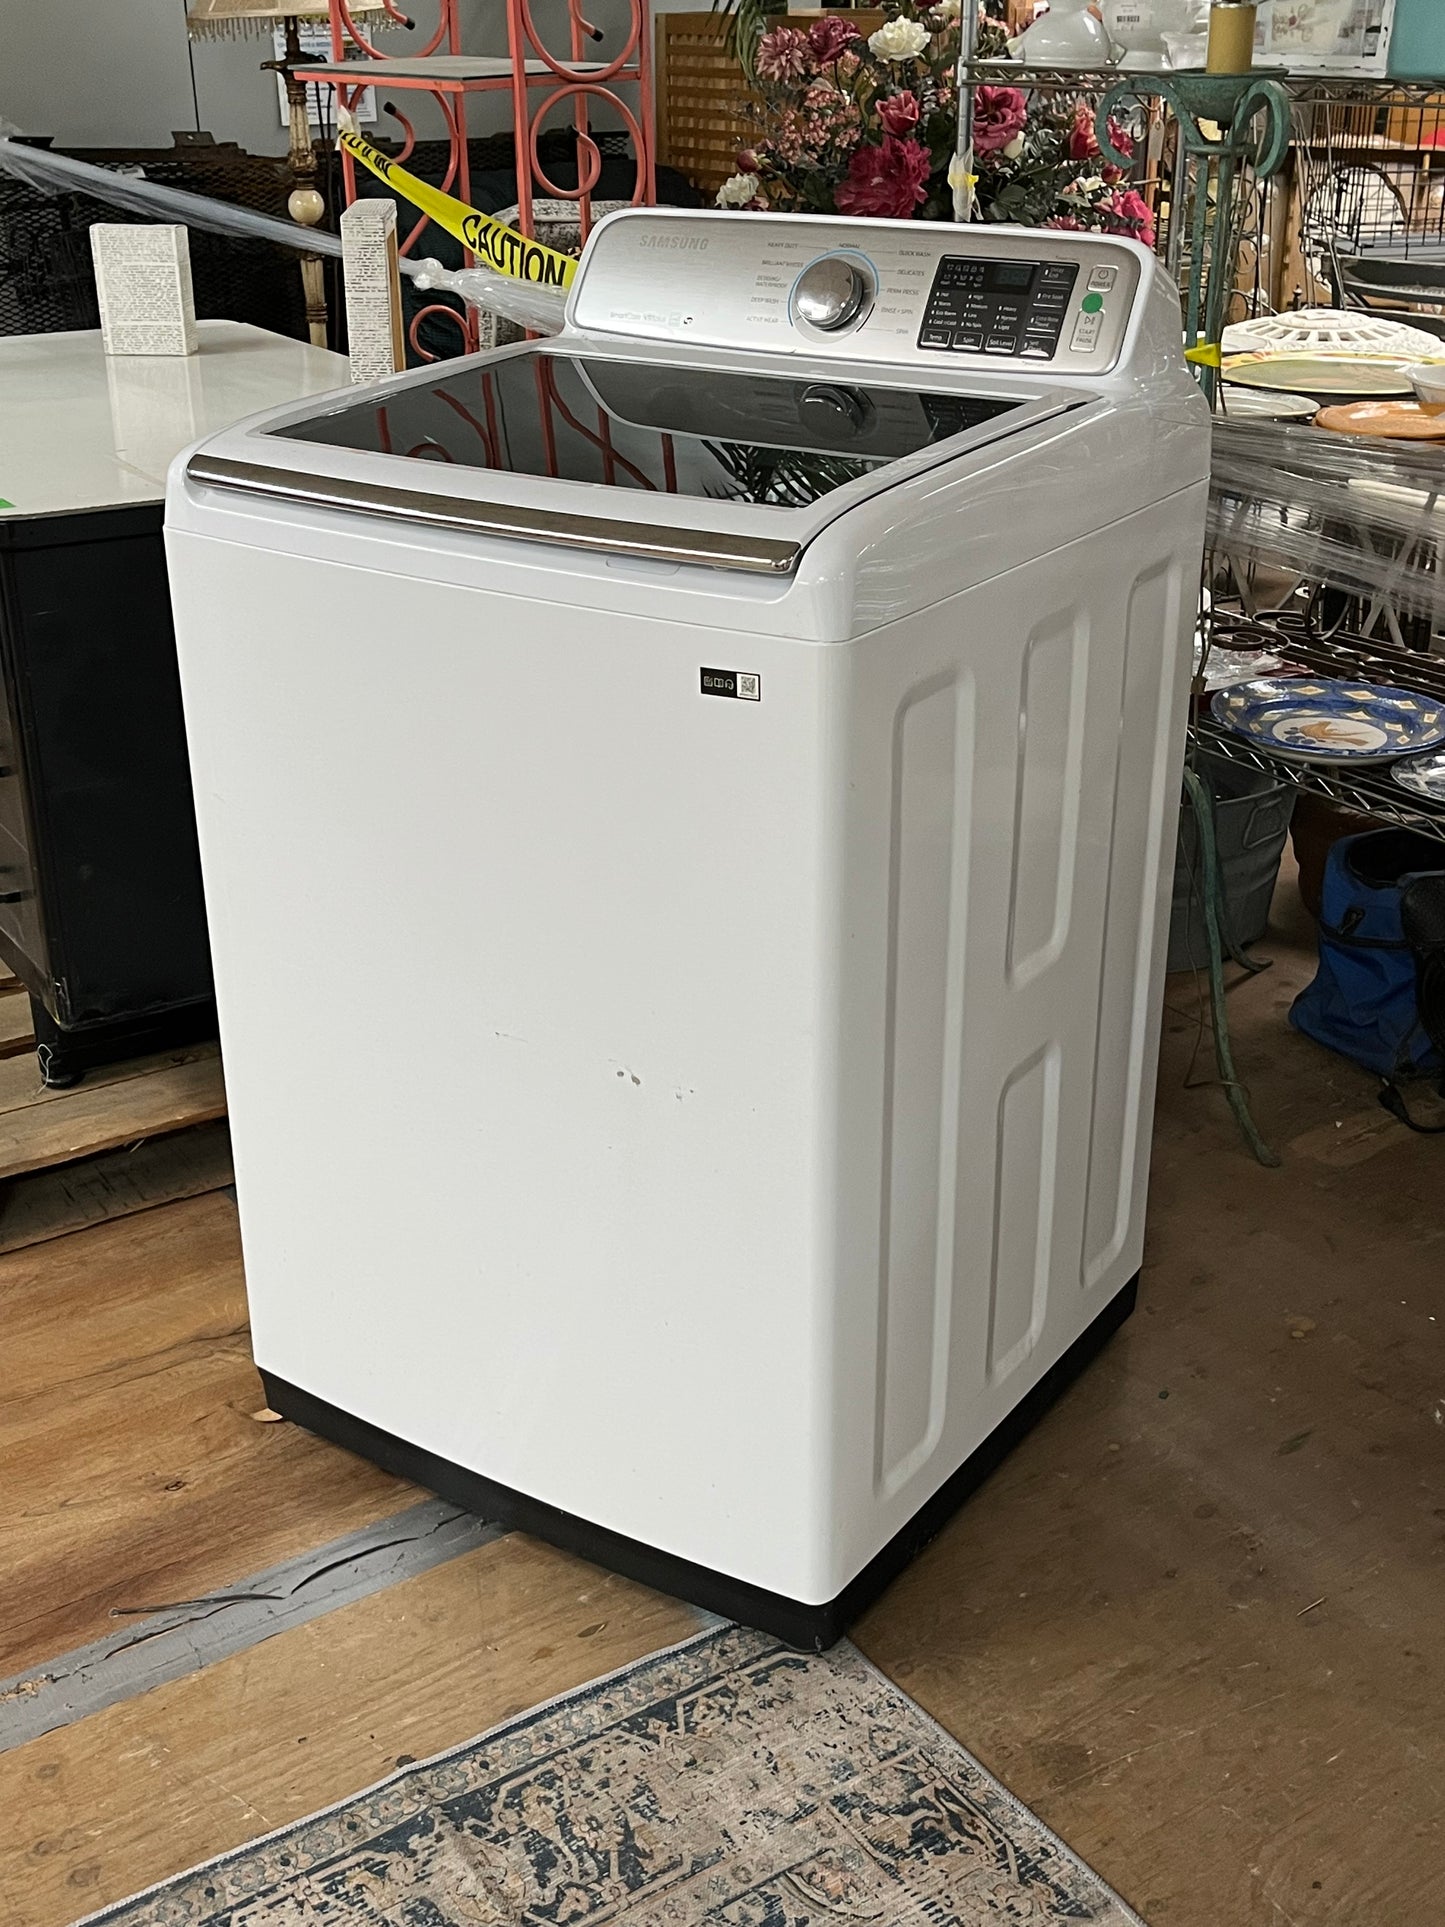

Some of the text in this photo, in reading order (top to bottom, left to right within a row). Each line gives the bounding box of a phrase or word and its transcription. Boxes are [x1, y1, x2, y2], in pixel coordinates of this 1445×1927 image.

[462, 214, 567, 286] CAUTION
[639, 235, 709, 250] SAMSUNG
[963, 336, 975, 344] Spin
